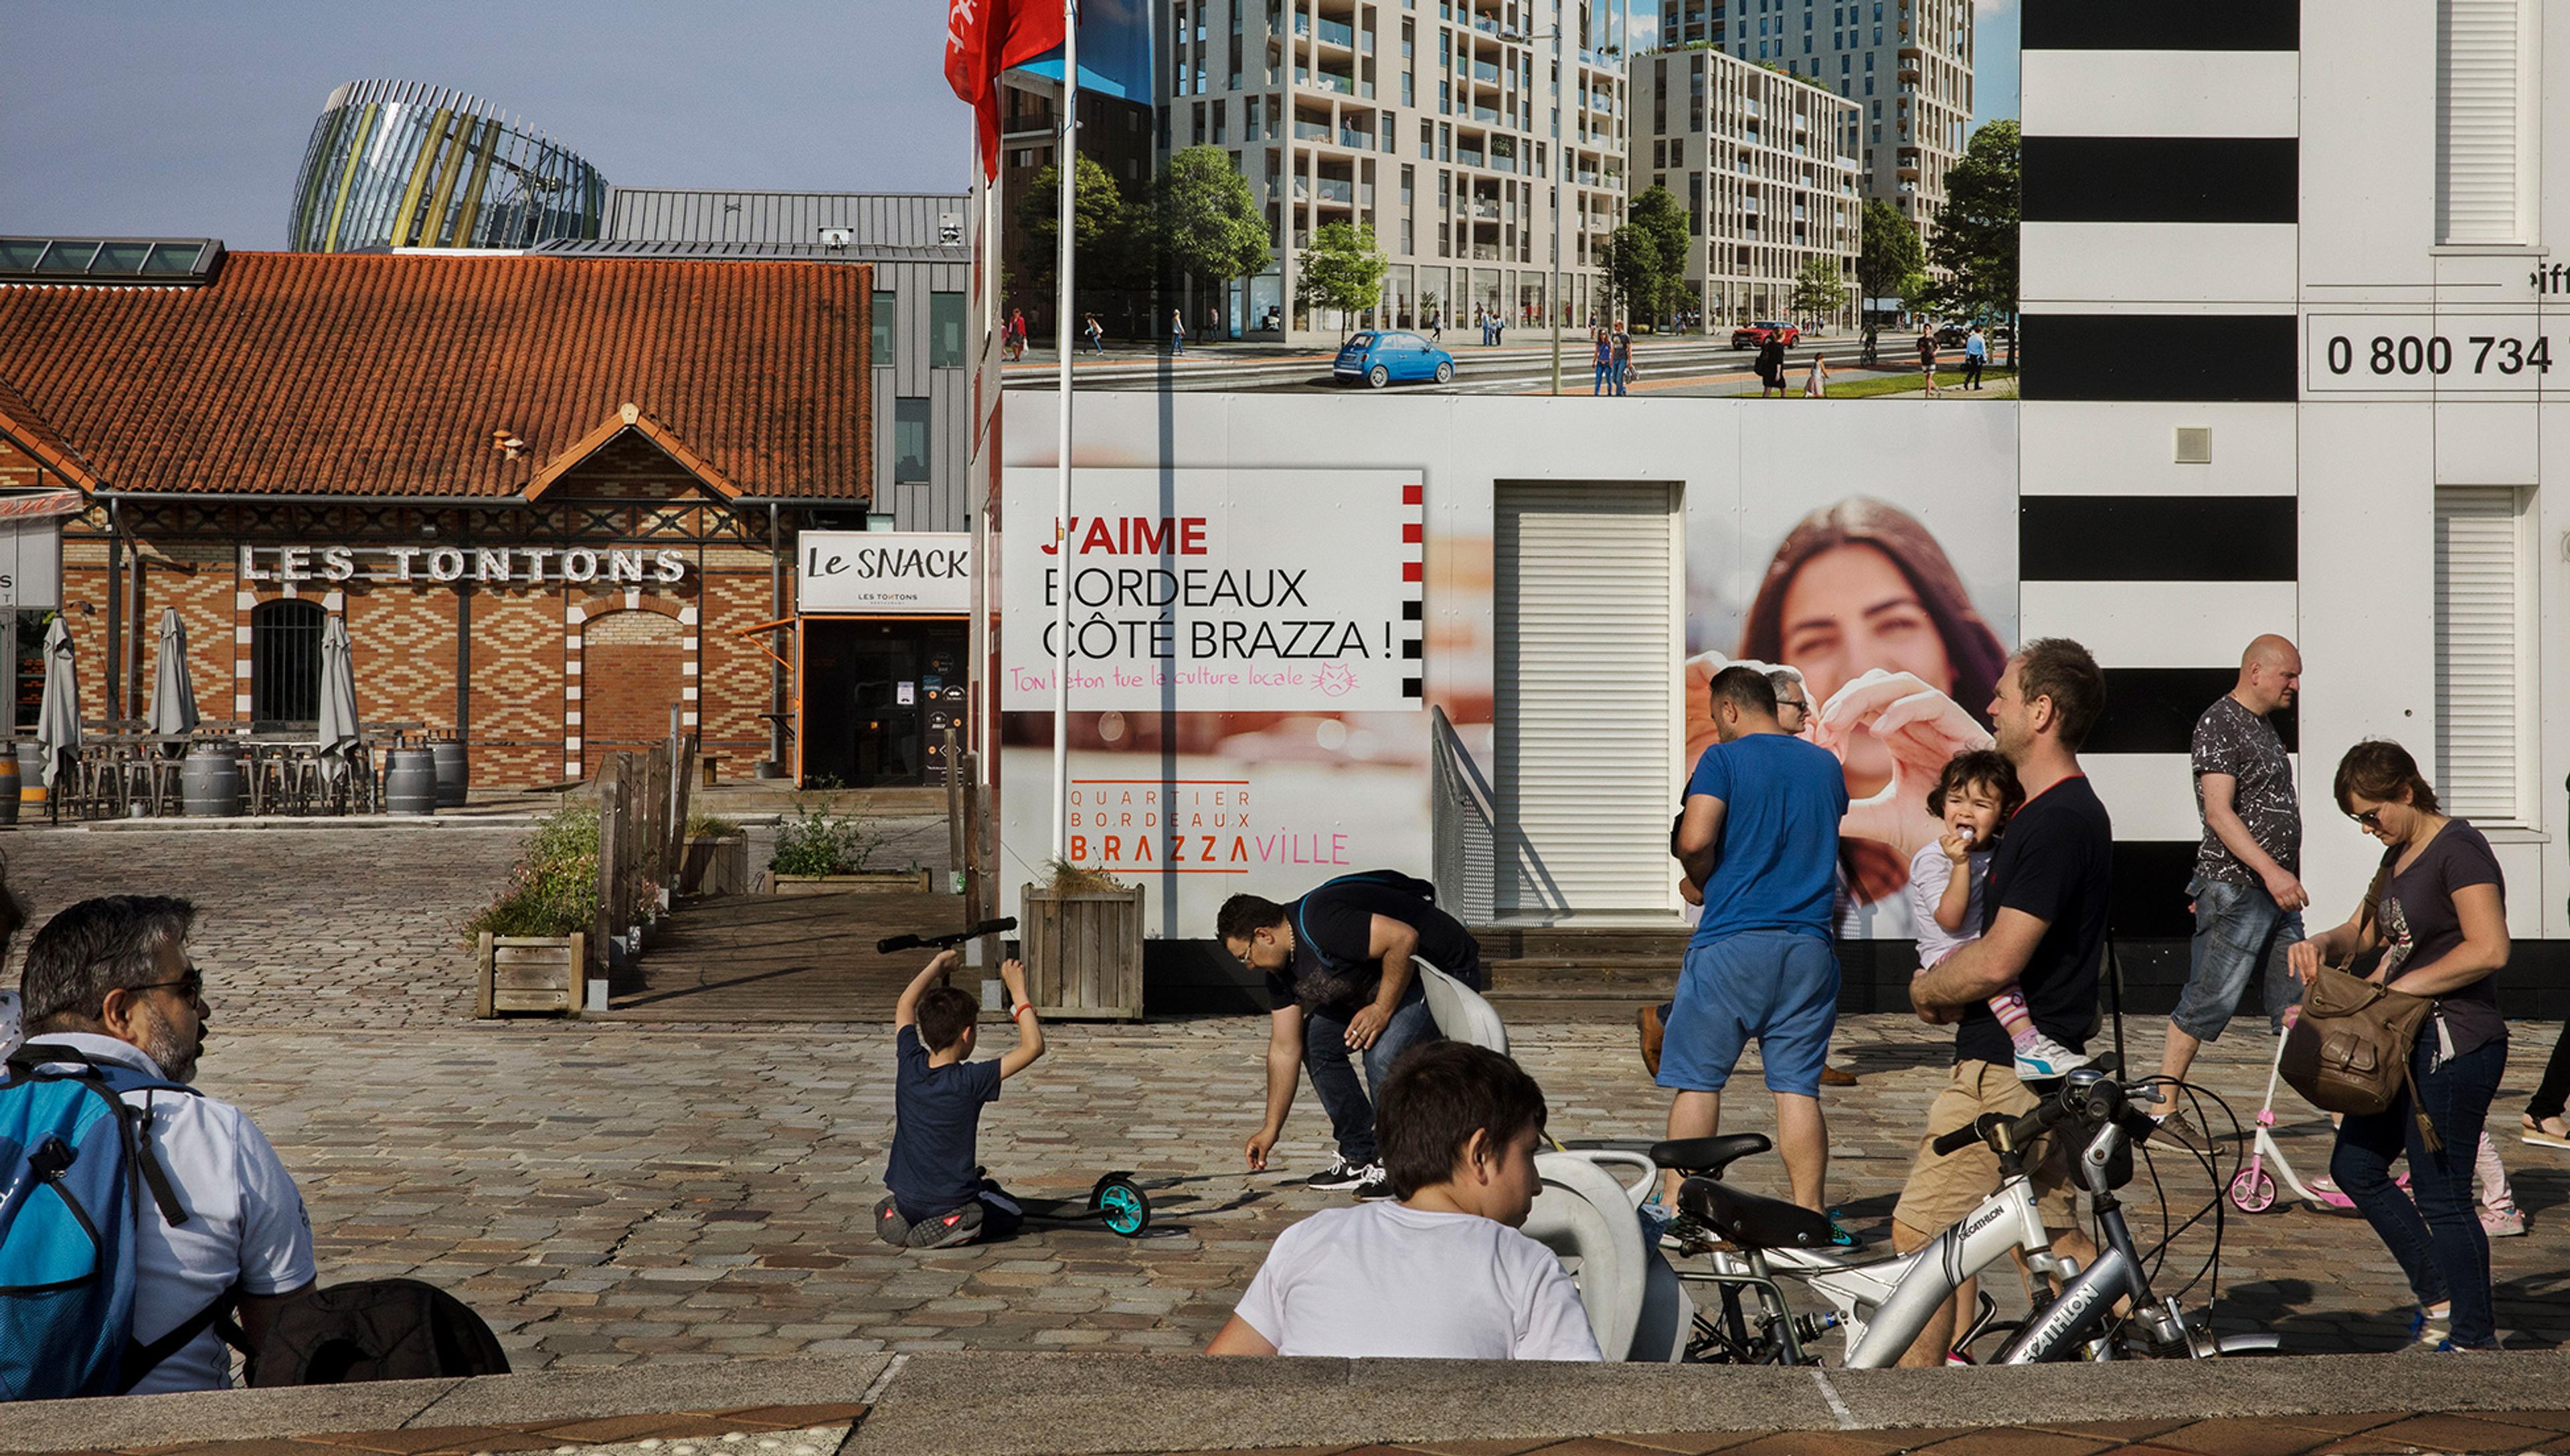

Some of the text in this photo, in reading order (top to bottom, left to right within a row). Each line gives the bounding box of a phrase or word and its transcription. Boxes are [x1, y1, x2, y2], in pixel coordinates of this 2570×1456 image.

[2328, 336, 2552, 374] 0 800 734
[240, 546, 685, 581] LES TONTONS
[808, 547, 968, 578] Le SNACK
[1045, 568, 1308, 607] BORDEAUX
[1043, 612, 1175, 658] CÔTÉ
[1191, 620, 1369, 658] BRAZZA
[1113, 666, 1144, 688] tue
[1151, 664, 1167, 687] la
[1173, 665, 1238, 686] culture
[1248, 664, 1304, 686] locale
[1071, 790, 1249, 806] QUARTIER
[1071, 812, 1250, 828] BORDEAUX
[1071, 835, 1248, 862] BRAZZA
[1958, 1204, 2004, 1241] DECATHLON
[2013, 1281, 2100, 1364] ECATHLON
